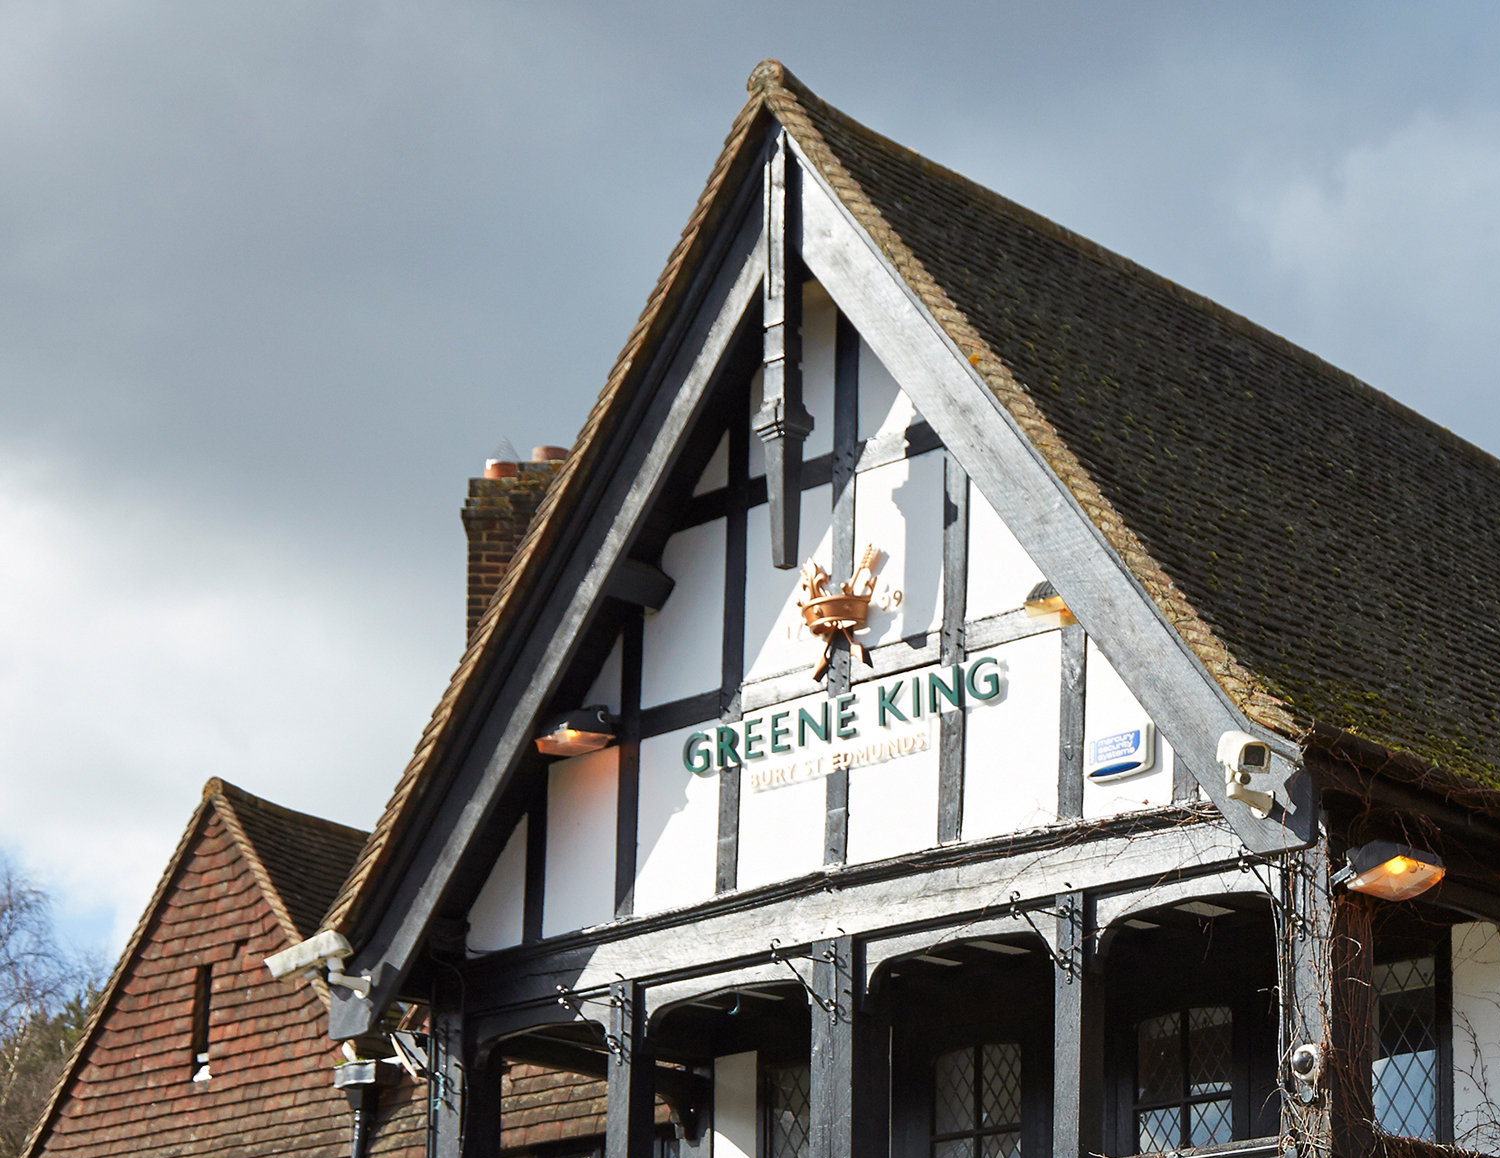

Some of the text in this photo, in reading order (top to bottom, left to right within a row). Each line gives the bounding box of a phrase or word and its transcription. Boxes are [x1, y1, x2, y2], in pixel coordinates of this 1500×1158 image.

[683, 656, 1004, 775] GREENE KING
[751, 733, 927, 788] BURY ST EDMUNDS
